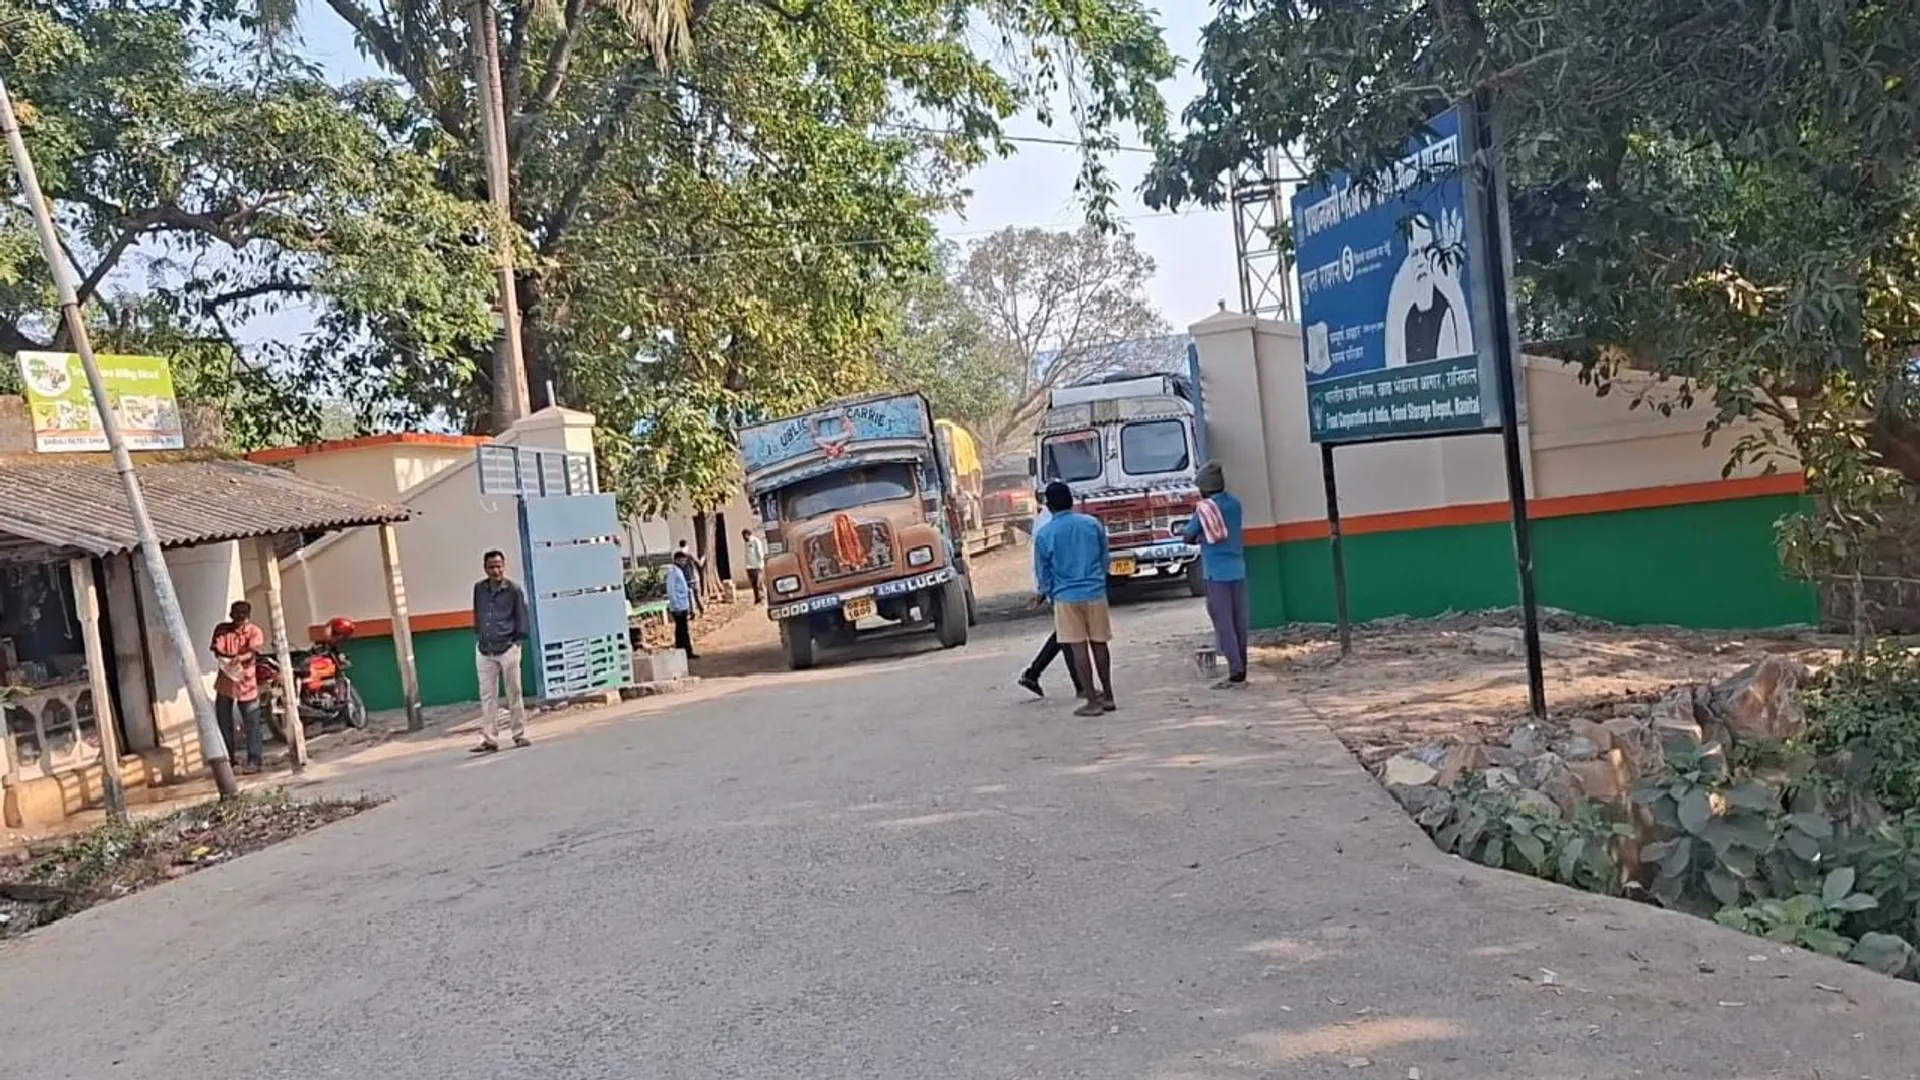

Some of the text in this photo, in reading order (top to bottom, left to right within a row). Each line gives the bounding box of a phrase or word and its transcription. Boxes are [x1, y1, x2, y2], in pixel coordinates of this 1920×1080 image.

[1326, 412, 1338, 429] Food
[1339, 409, 1367, 431] Corporation
[1367, 406, 1374, 424] of
[1391, 403, 1407, 421] Food
[1407, 401, 1431, 423] Storage
[1454, 395, 1480, 416] Ranital
[770, 602, 808, 620] GOOD
